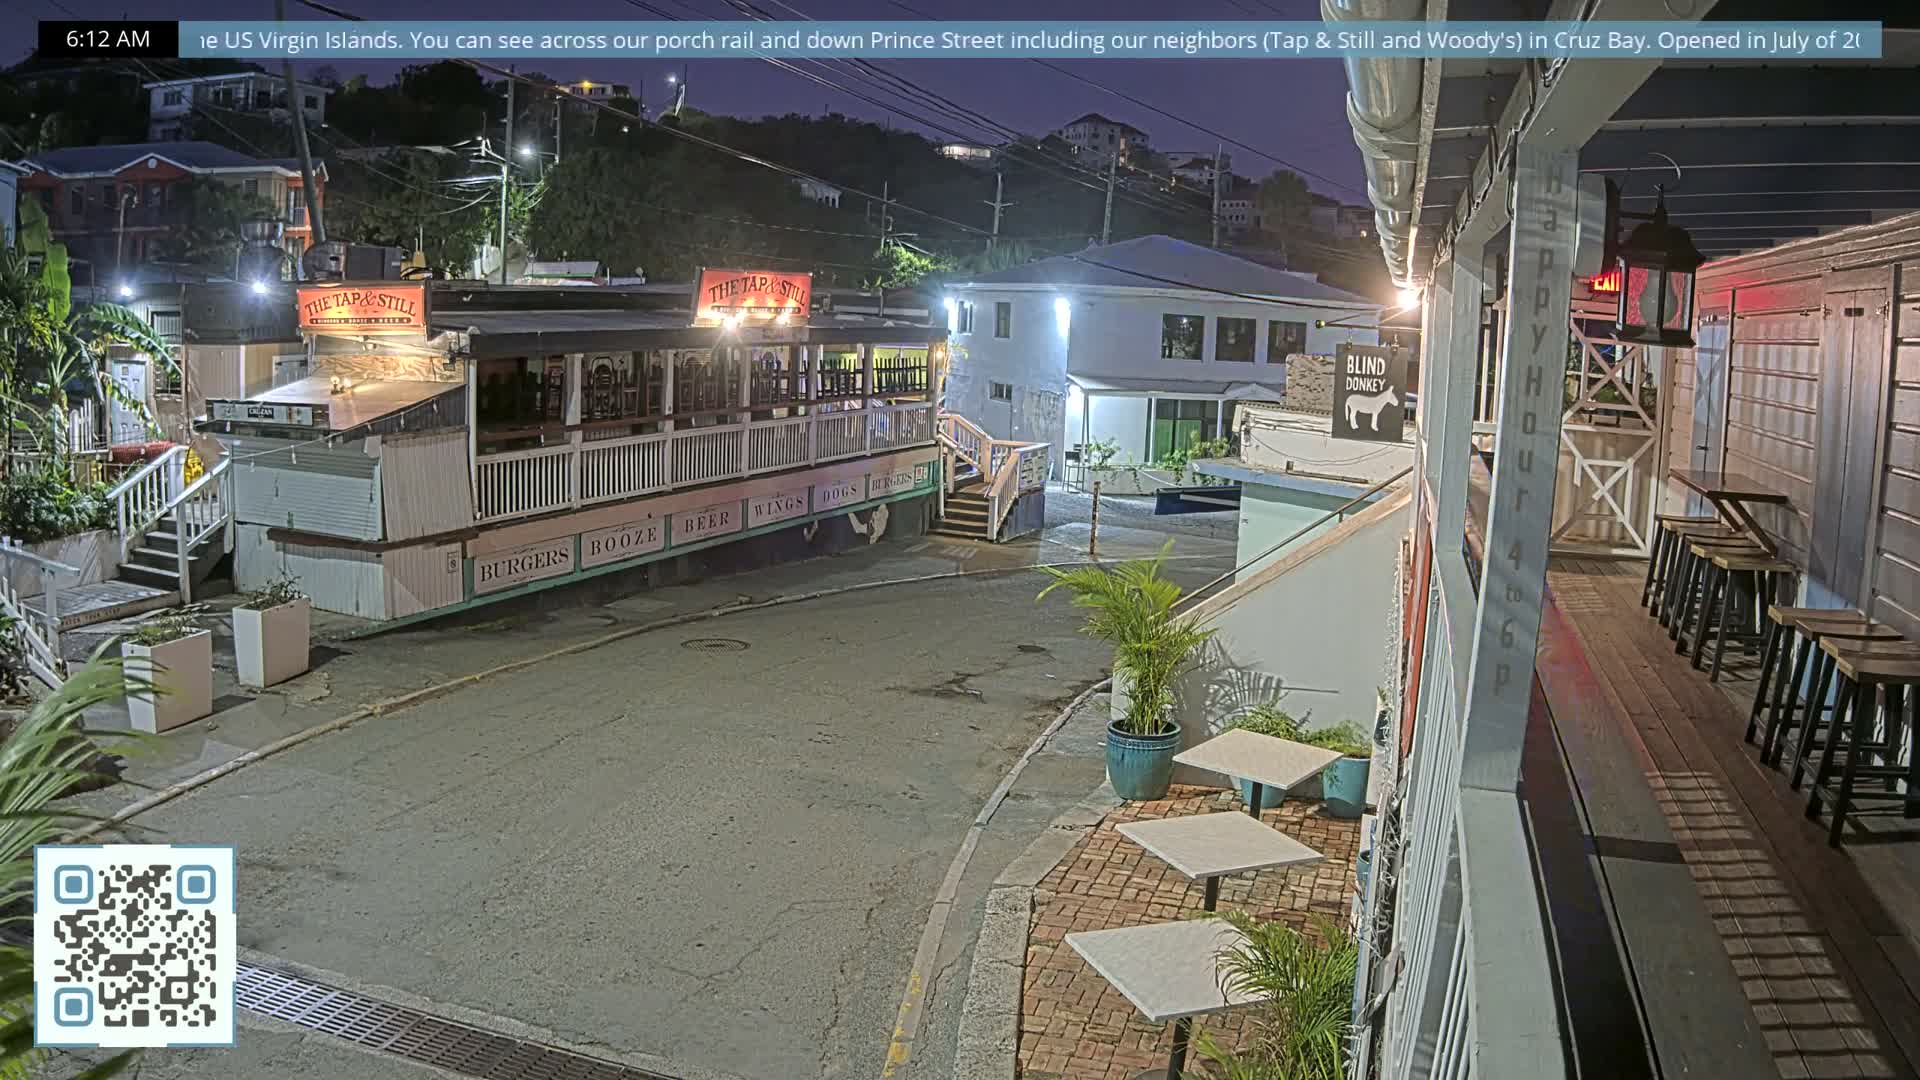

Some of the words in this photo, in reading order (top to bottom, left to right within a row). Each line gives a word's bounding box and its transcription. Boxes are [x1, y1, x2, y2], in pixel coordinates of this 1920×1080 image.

[708, 279, 740, 303] THE
[741, 275, 768, 293] TAP
[765, 277, 779, 295] &
[779, 279, 807, 307] STILL
[304, 293, 332, 317] THE
[333, 291, 361, 308] TAP
[359, 290, 378, 308] &
[377, 293, 417, 317] STILL
[1346, 354, 1386, 376] BLIND
[1345, 376, 1386, 392] DONKEY
[871, 472, 912, 491] BURGERS
[822, 486, 858, 503] DOGS
[754, 496, 804, 518] WINGS
[684, 510, 730, 533] BEER
[590, 527, 658, 556] BOOZE
[480, 547, 570, 583] BURGERS
